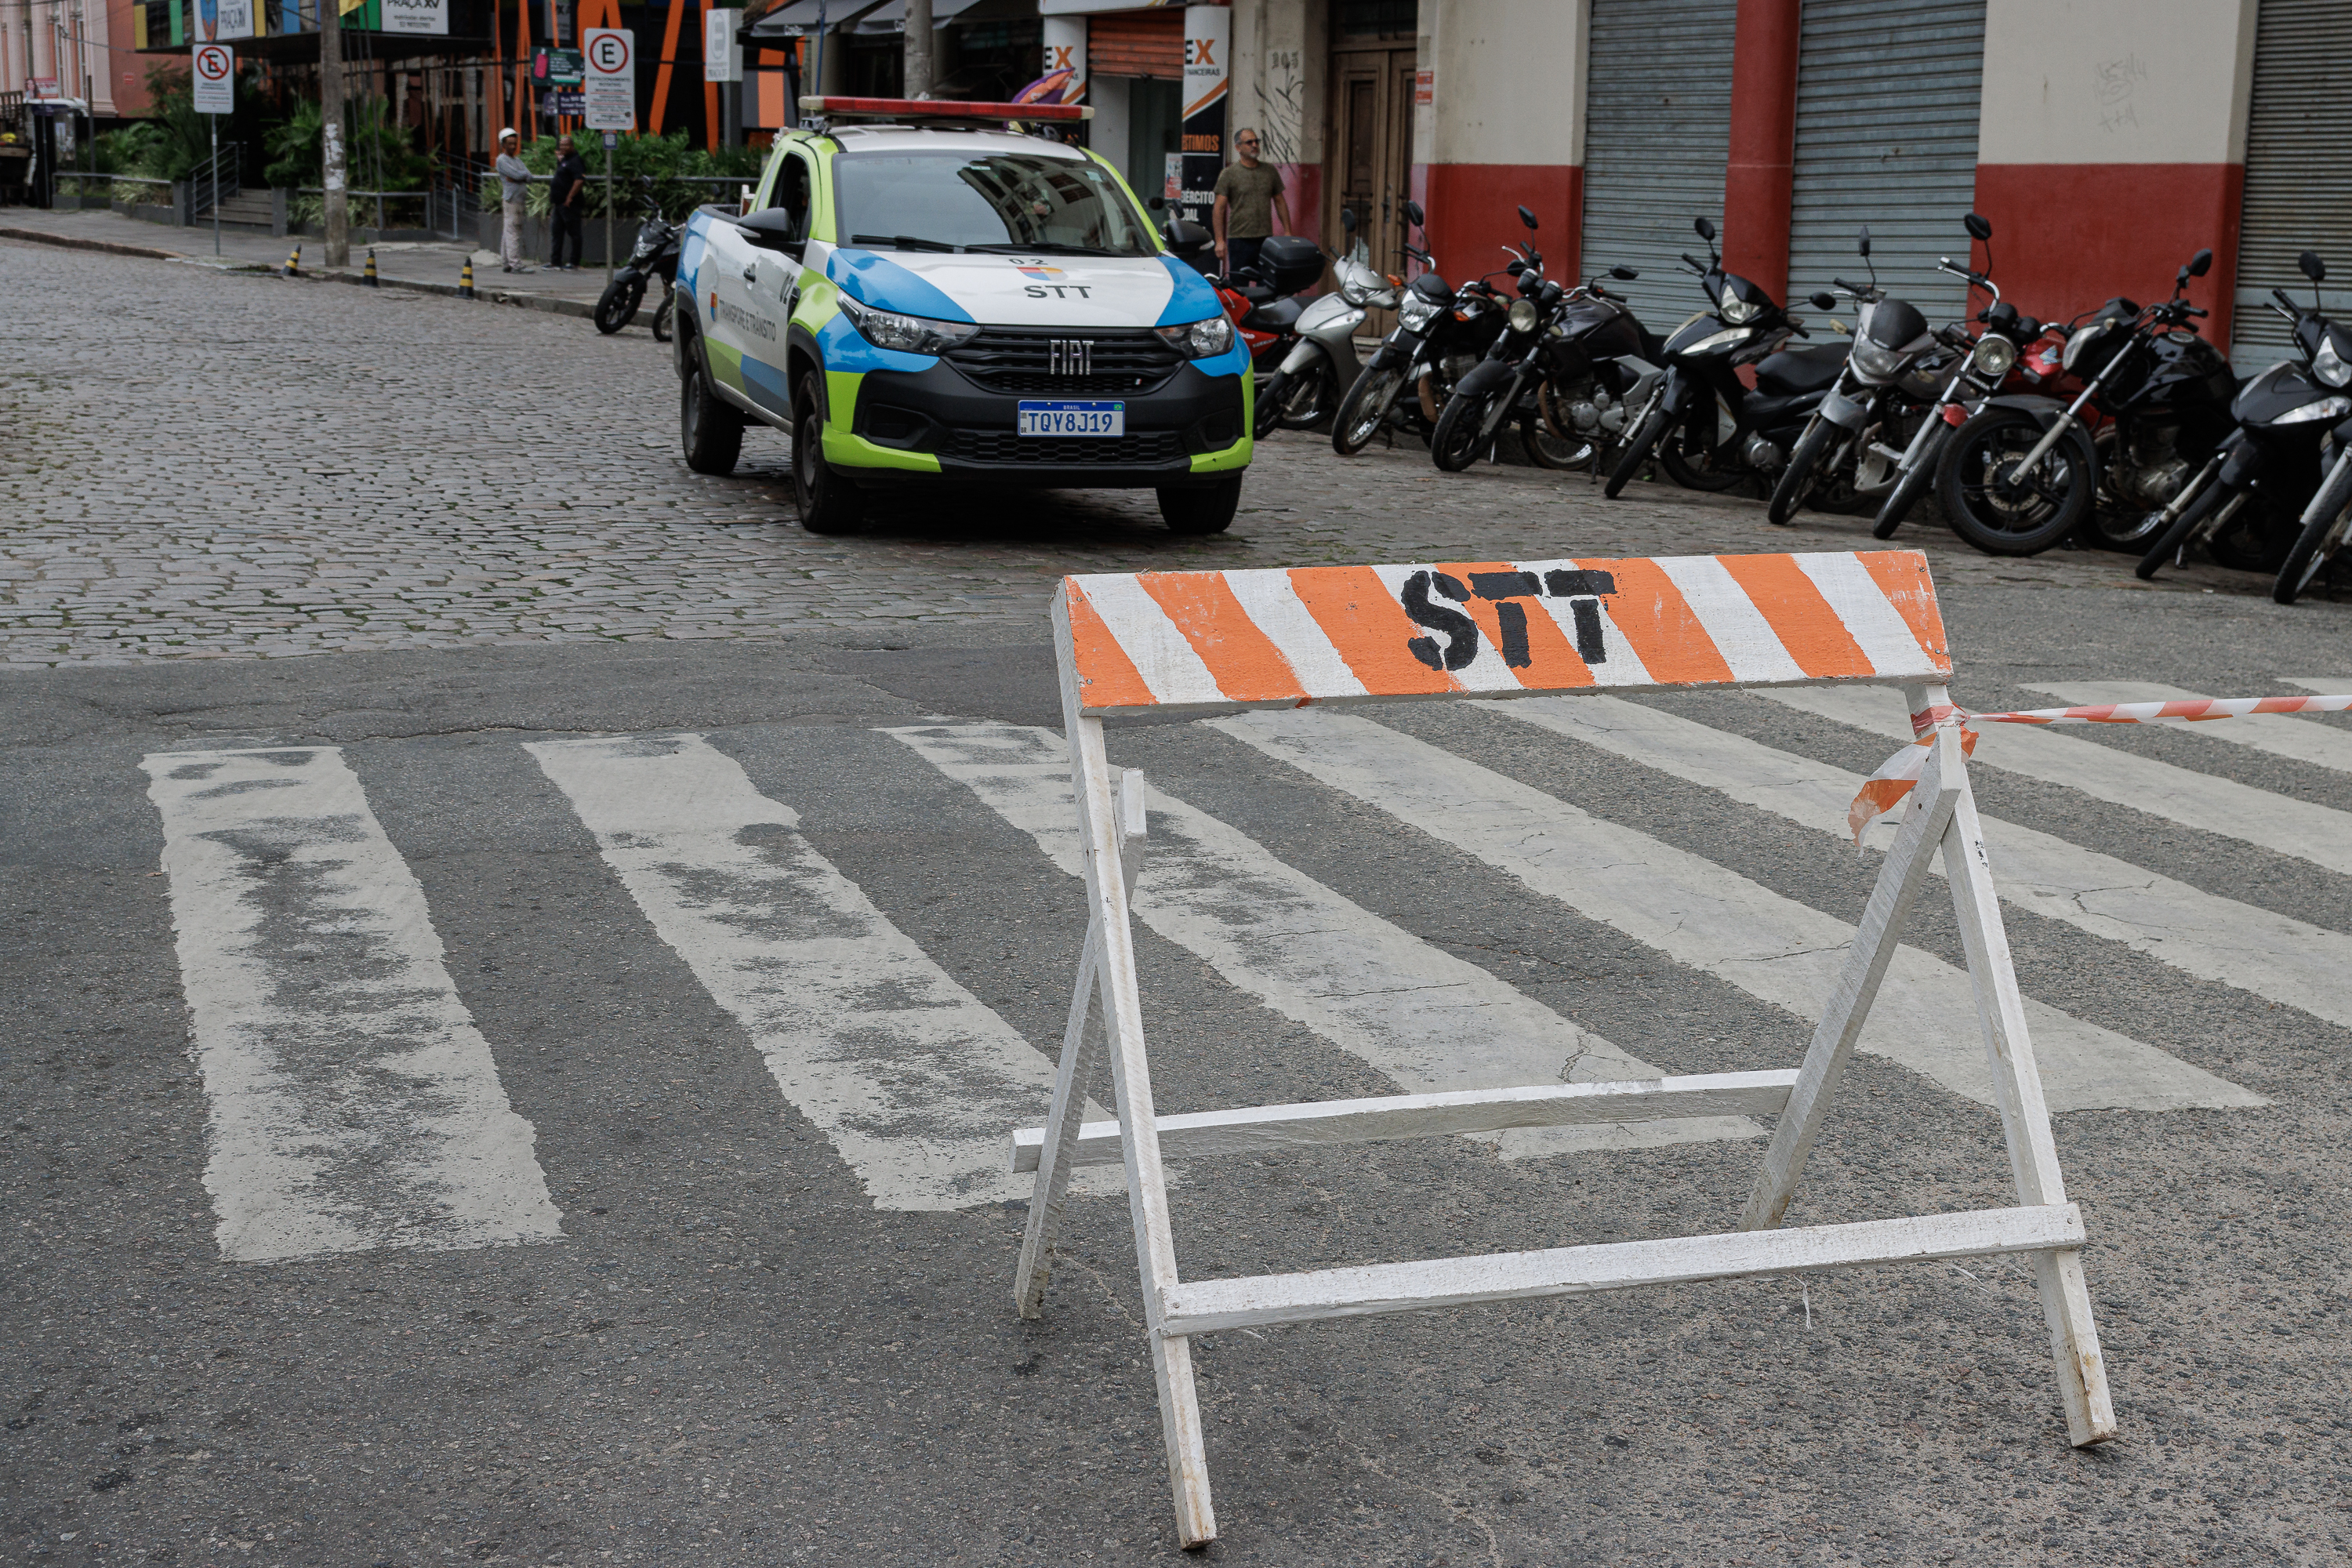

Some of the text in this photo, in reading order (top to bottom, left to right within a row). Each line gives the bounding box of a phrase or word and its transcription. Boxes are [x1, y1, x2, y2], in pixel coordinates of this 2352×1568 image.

[208, 54, 219, 72] E
[602, 43, 615, 64] E
[1024, 285, 1091, 299] STT
[1050, 339, 1094, 376] FIAT
[1028, 412, 1112, 433] TQY8J19
[1401, 569, 1617, 672] STT
